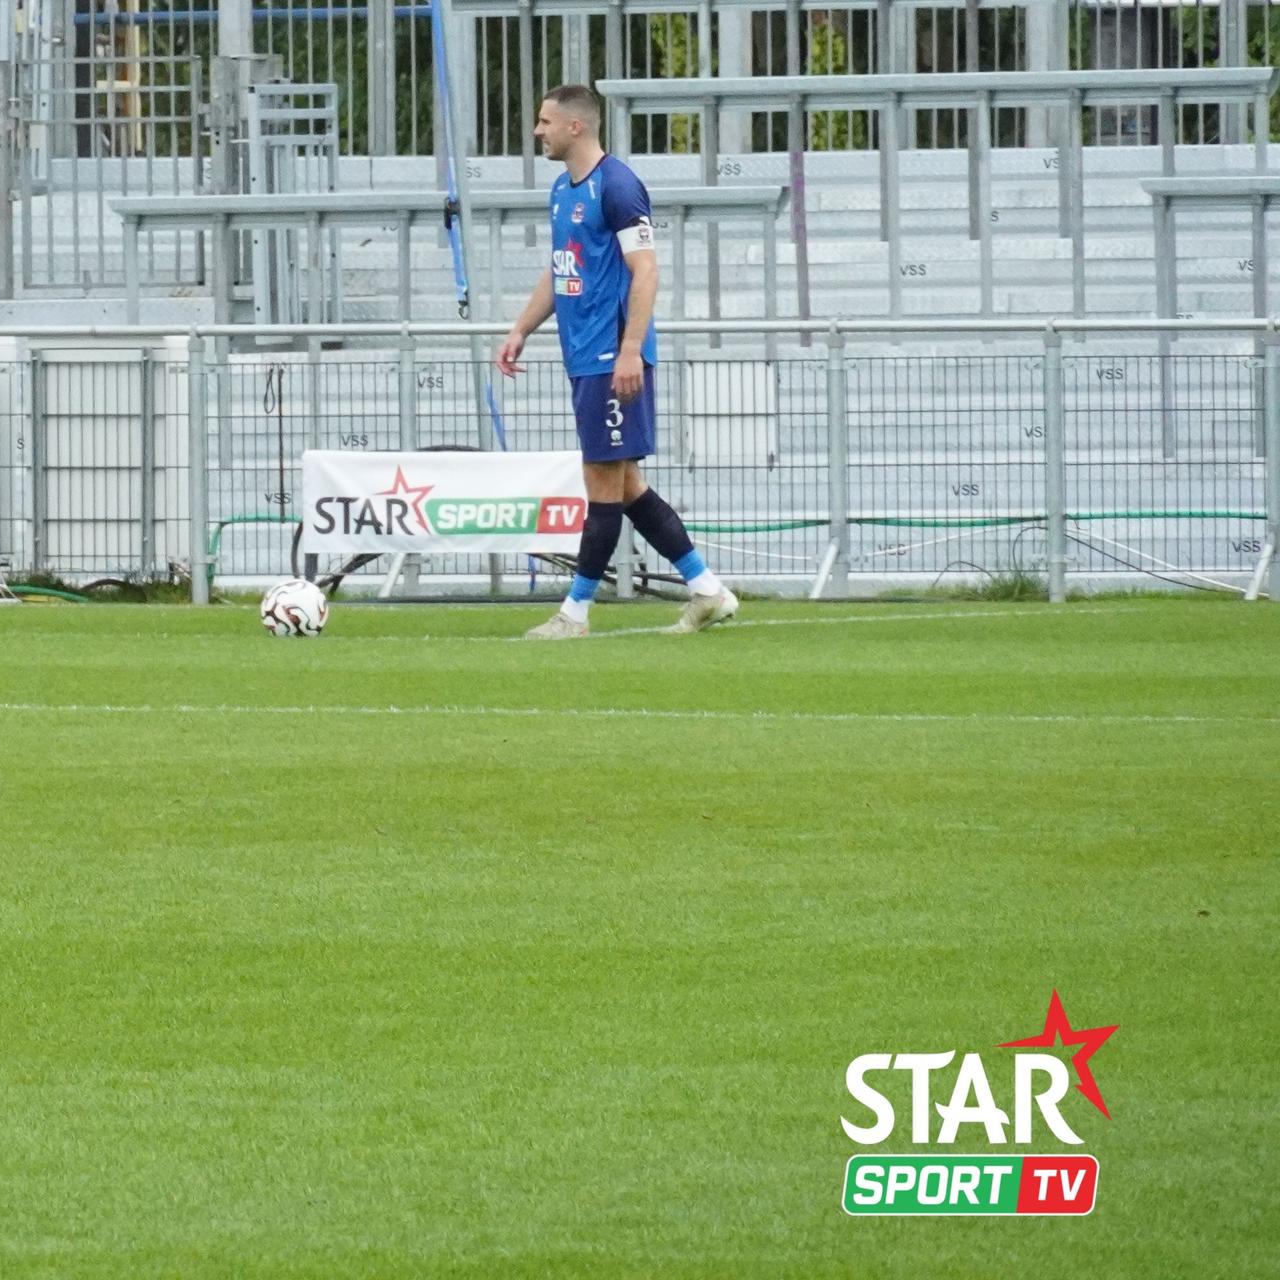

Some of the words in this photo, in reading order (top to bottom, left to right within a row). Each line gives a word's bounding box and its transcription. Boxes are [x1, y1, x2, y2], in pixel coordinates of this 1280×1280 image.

[900, 264, 926, 276] VSS
[1096, 368, 1124, 380] VSS
[417, 376, 444, 389] VSS
[606, 399, 624, 427] 3
[342, 435, 368, 447] VSS
[953, 484, 980, 496] VSS
[313, 497, 415, 535] STAR
[437, 502, 536, 529] SPORT
[546, 505, 580, 527] TV
[1232, 540, 1261, 552] VSS
